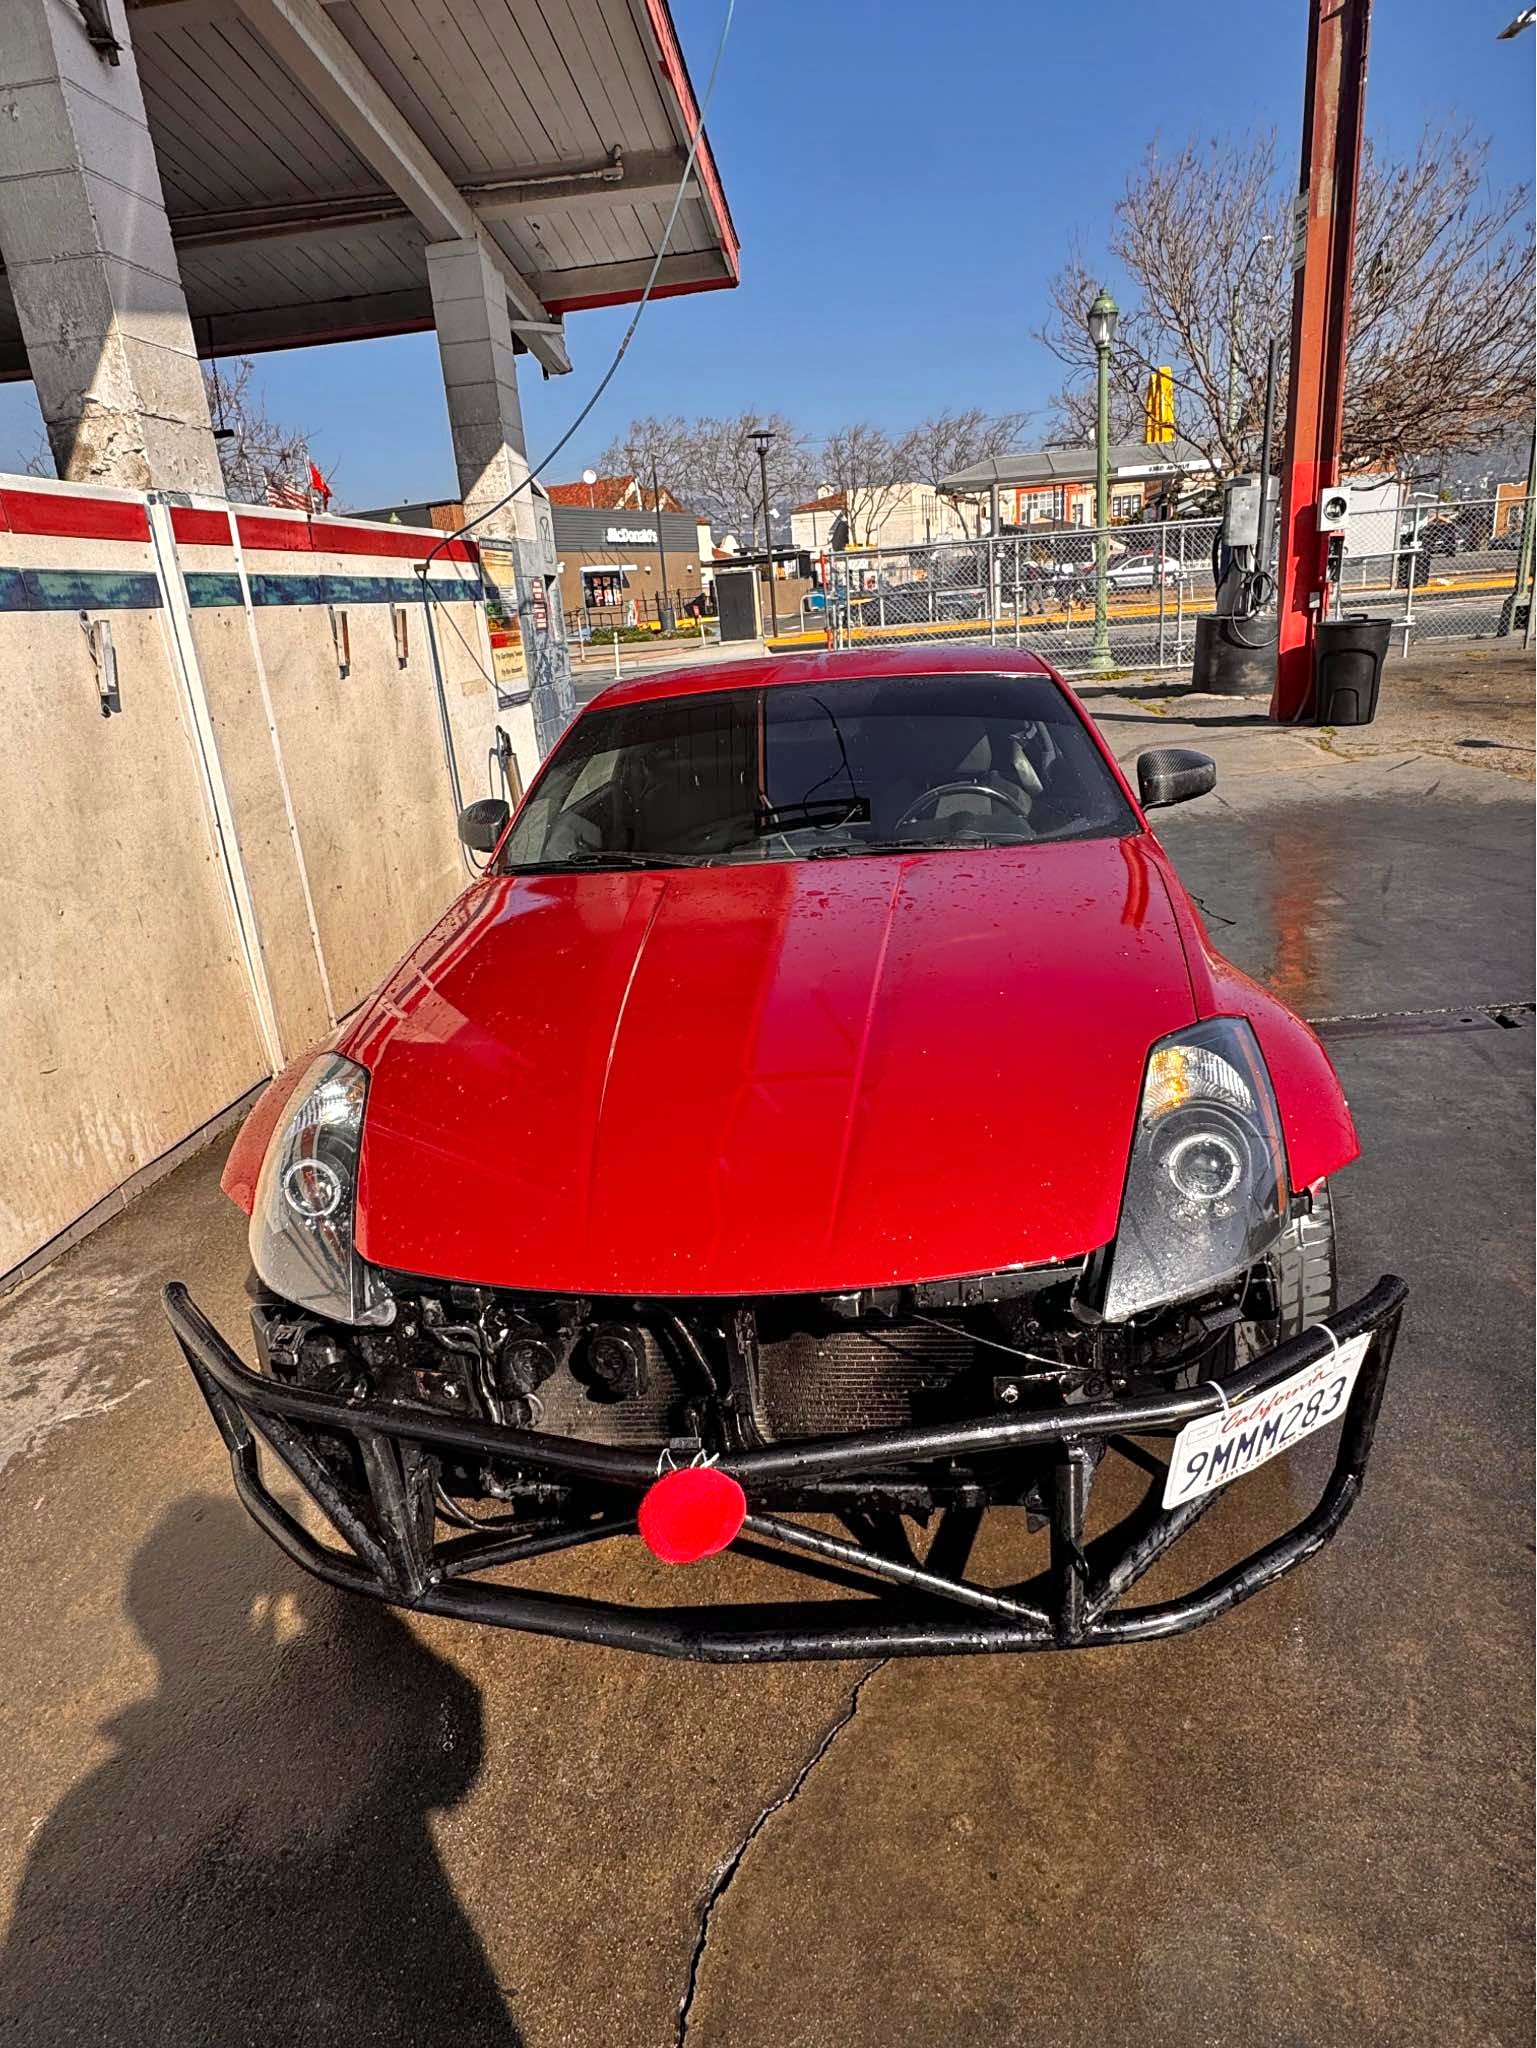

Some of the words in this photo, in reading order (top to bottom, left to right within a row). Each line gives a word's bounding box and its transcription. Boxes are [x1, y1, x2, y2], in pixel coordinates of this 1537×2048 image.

[606, 527, 658, 543] McDonald's
[1221, 1368, 1333, 1434] California
[1180, 1376, 1347, 1494] 9MMM283
